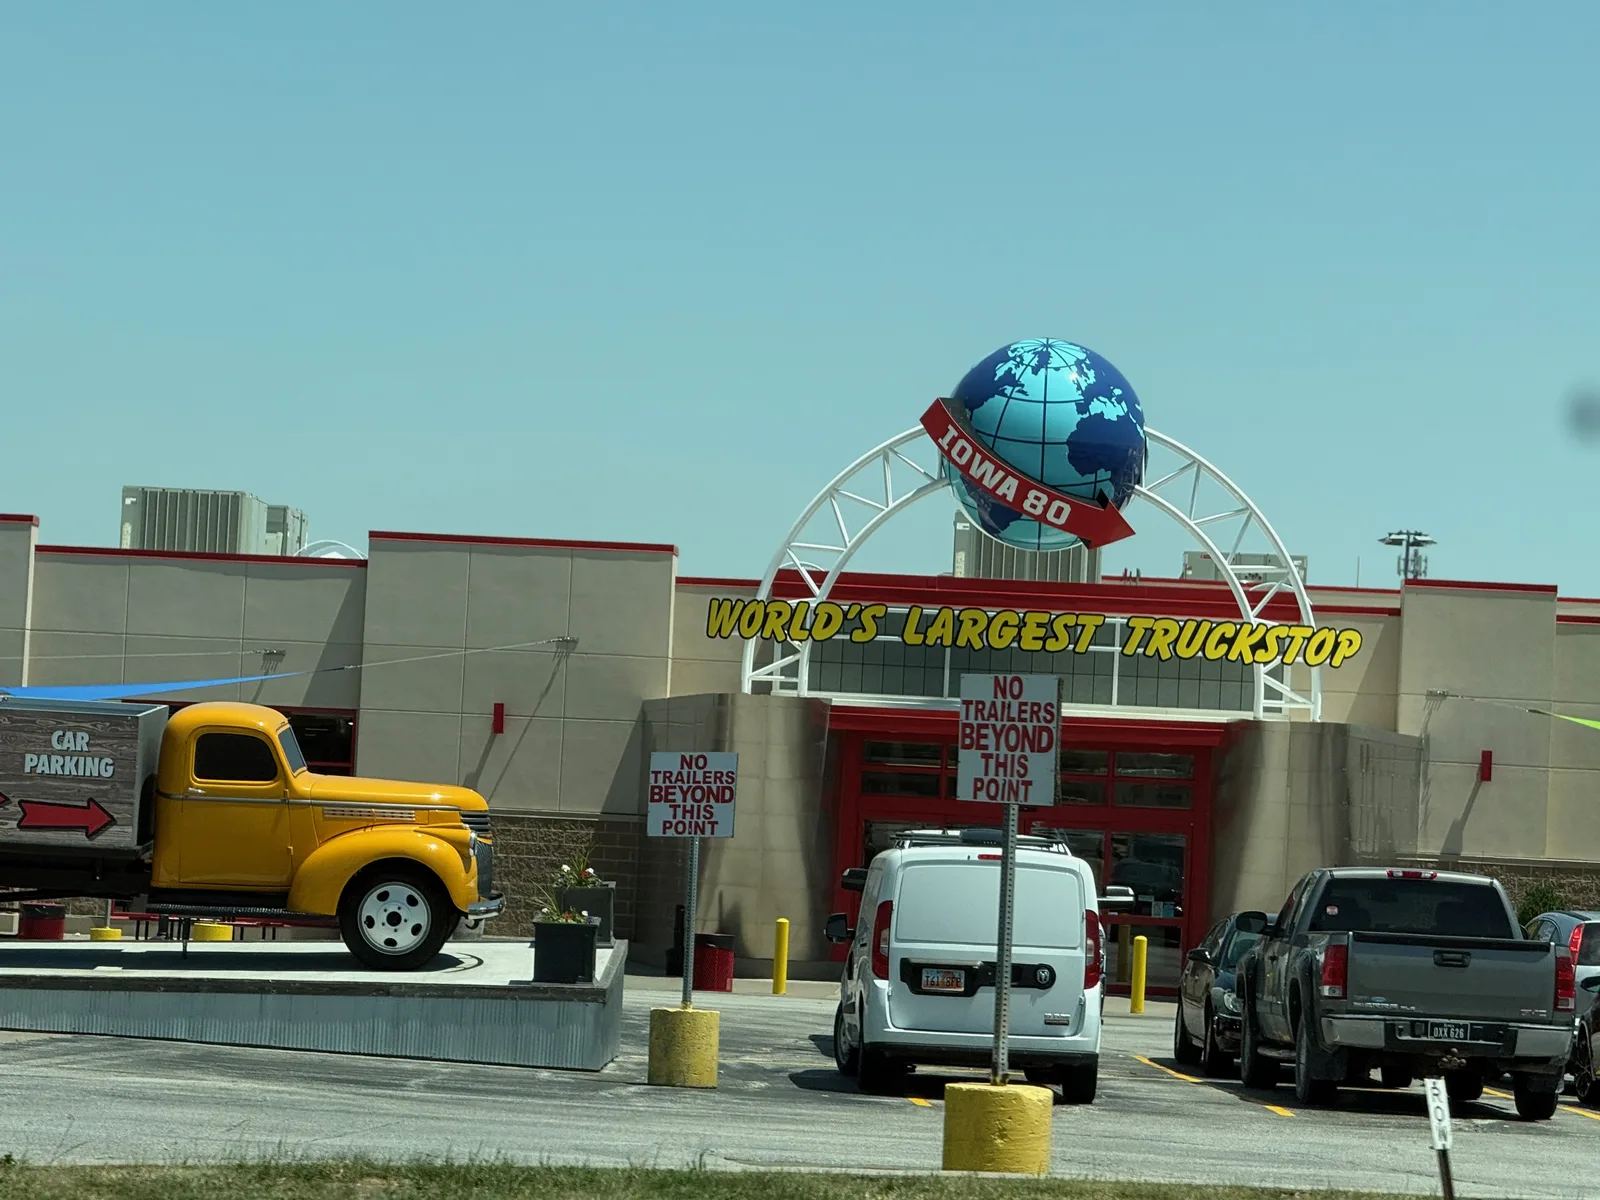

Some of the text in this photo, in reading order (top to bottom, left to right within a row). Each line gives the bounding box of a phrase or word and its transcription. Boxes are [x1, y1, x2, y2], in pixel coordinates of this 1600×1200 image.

[938, 424, 1072, 525] IOWA 80
[706, 598, 1363, 667] WORLD'S LARGEST TRUCKSTOP
[993, 675, 1024, 700] NO
[961, 699, 1056, 724] TRAILERS
[51, 730, 90, 752] CAR
[960, 721, 1054, 753] BEYOND
[24, 753, 114, 778] PARKING
[680, 754, 708, 770] NO
[981, 752, 1029, 779] THIS
[651, 770, 735, 785] TRAILERS
[972, 777, 1033, 803] POINT
[649, 785, 734, 804] BEYOND
[669, 804, 715, 820] THIS
[662, 820, 719, 836] POINT
[1450, 1028, 1465, 1039] 626
